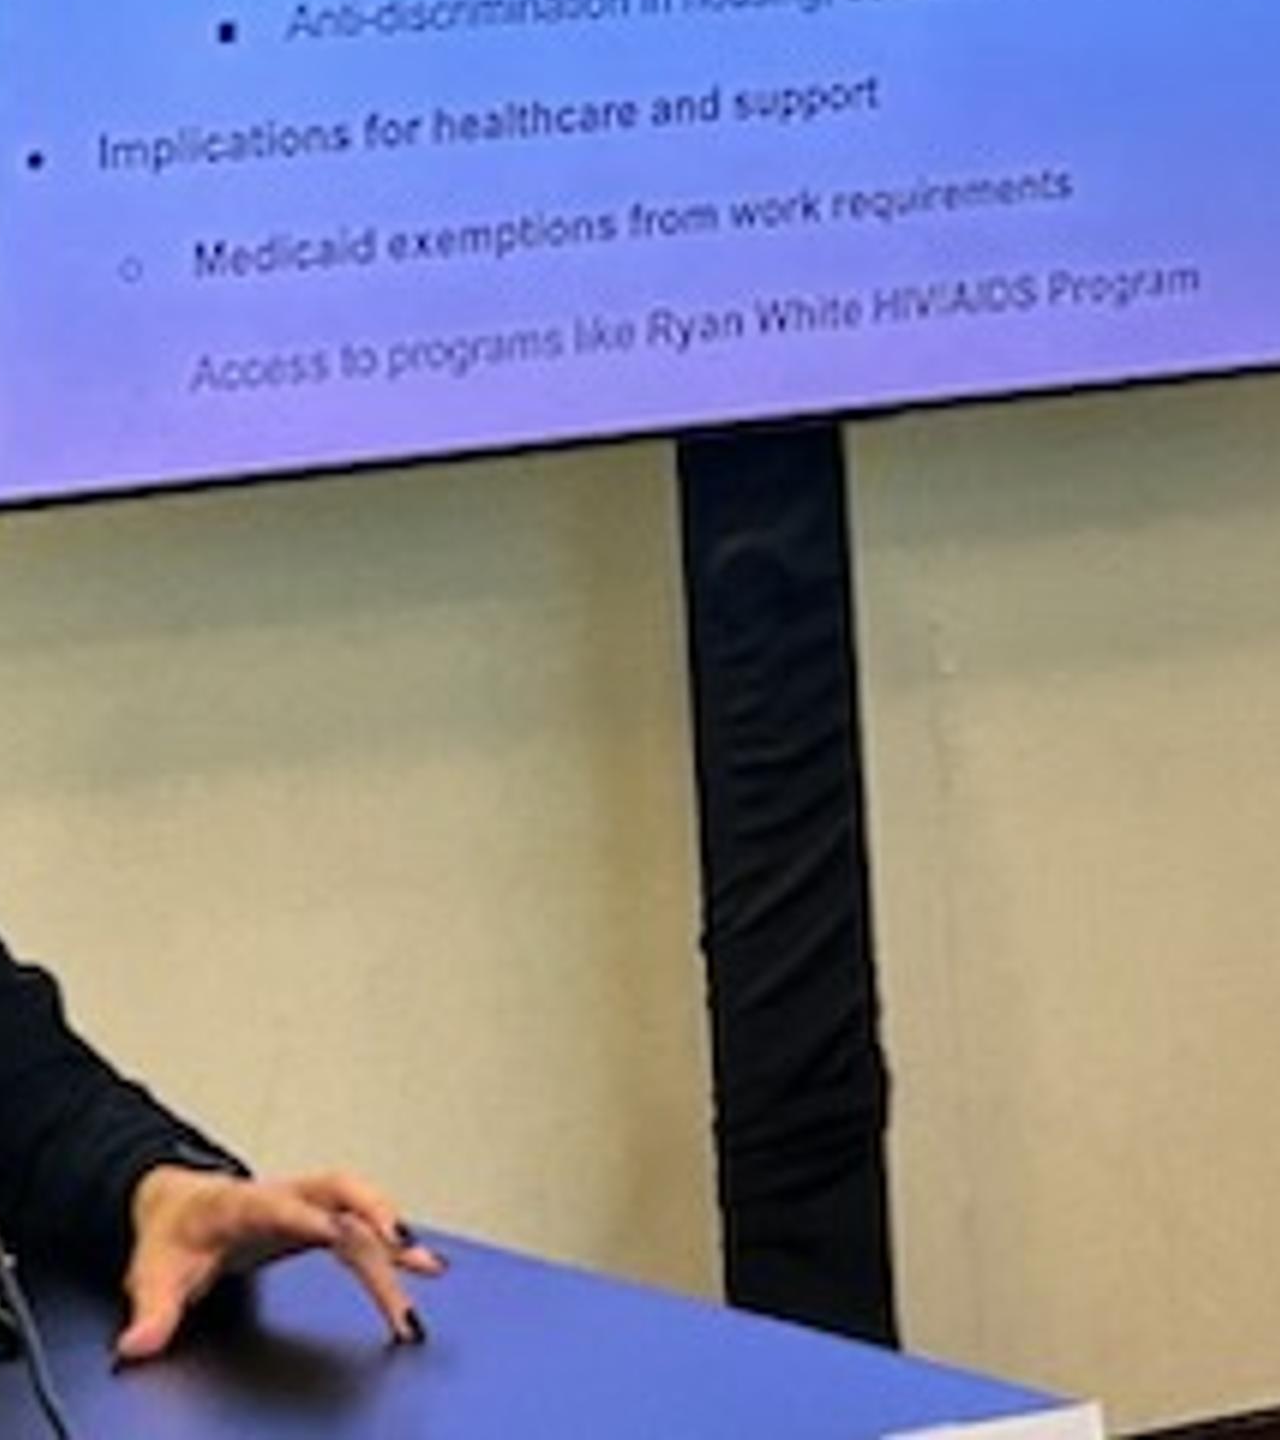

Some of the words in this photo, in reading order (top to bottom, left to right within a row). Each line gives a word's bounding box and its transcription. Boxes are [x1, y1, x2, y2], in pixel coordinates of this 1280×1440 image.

[100, 120, 351, 172] Implications
[364, 113, 423, 149] for
[433, 99, 636, 145] healthcare
[652, 87, 719, 127] and
[734, 76, 880, 123] support
[194, 227, 375, 278] Medicaid
[388, 211, 616, 260] exemptions
[628, 200, 718, 238] from
[730, 188, 820, 228] work
[831, 167, 1073, 220] requirements
[190, 351, 322, 392] Access
[340, 344, 378, 380] to
[388, 323, 563, 381] programs
[575, 315, 635, 354] like
[646, 307, 743, 354] Ryan
[754, 295, 860, 336] White
[873, 271, 1038, 321] HIV/AIDS
[1048, 262, 1201, 307] Program
